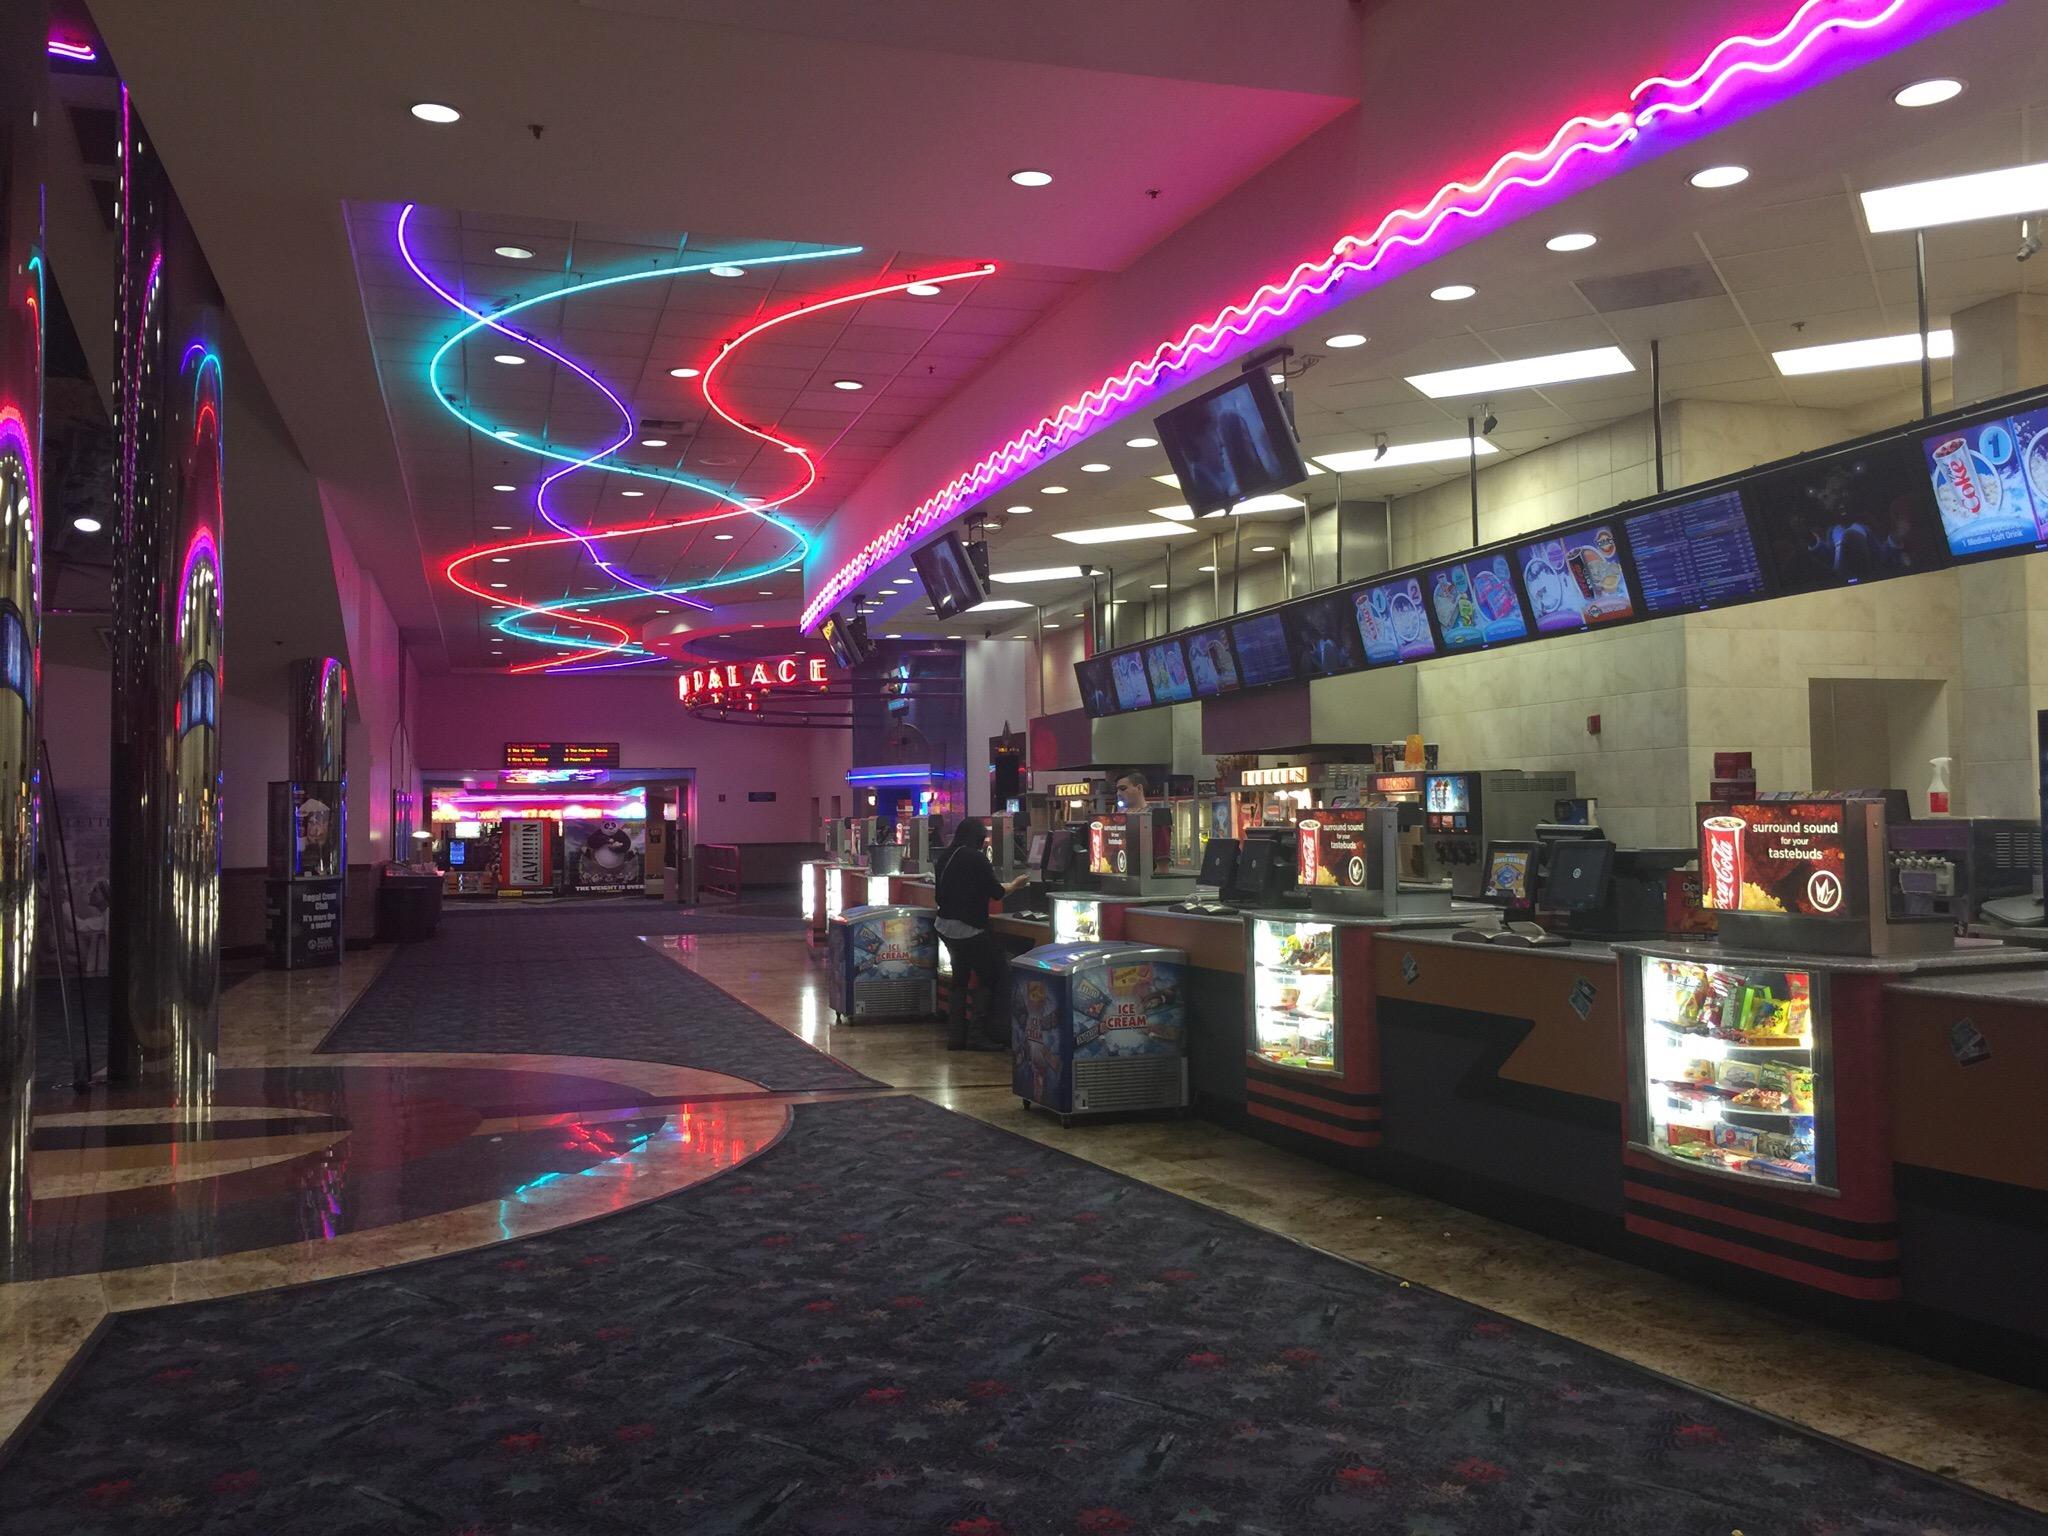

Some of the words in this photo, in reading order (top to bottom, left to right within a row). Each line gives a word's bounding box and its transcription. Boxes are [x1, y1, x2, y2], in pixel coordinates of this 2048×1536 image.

[1988, 432, 2001, 458] 1
[1950, 460, 1981, 513] Coke
[1991, 532, 2005, 541] Soft
[2005, 530, 2024, 539] Drink
[692, 658, 828, 689] PALACE
[1323, 823, 1346, 832] surround
[1347, 822, 1364, 832] sound
[1752, 821, 1801, 834] surround
[1803, 821, 1838, 834] sound
[1330, 841, 1357, 850] tastebuds
[1780, 836, 1791, 846] for
[1792, 837, 1809, 847] your
[1768, 846, 1823, 860] tastebuds
[881, 952, 910, 960] CREAM
[1118, 1003, 1135, 1014] ICE
[1107, 1015, 1147, 1028] CREAM
